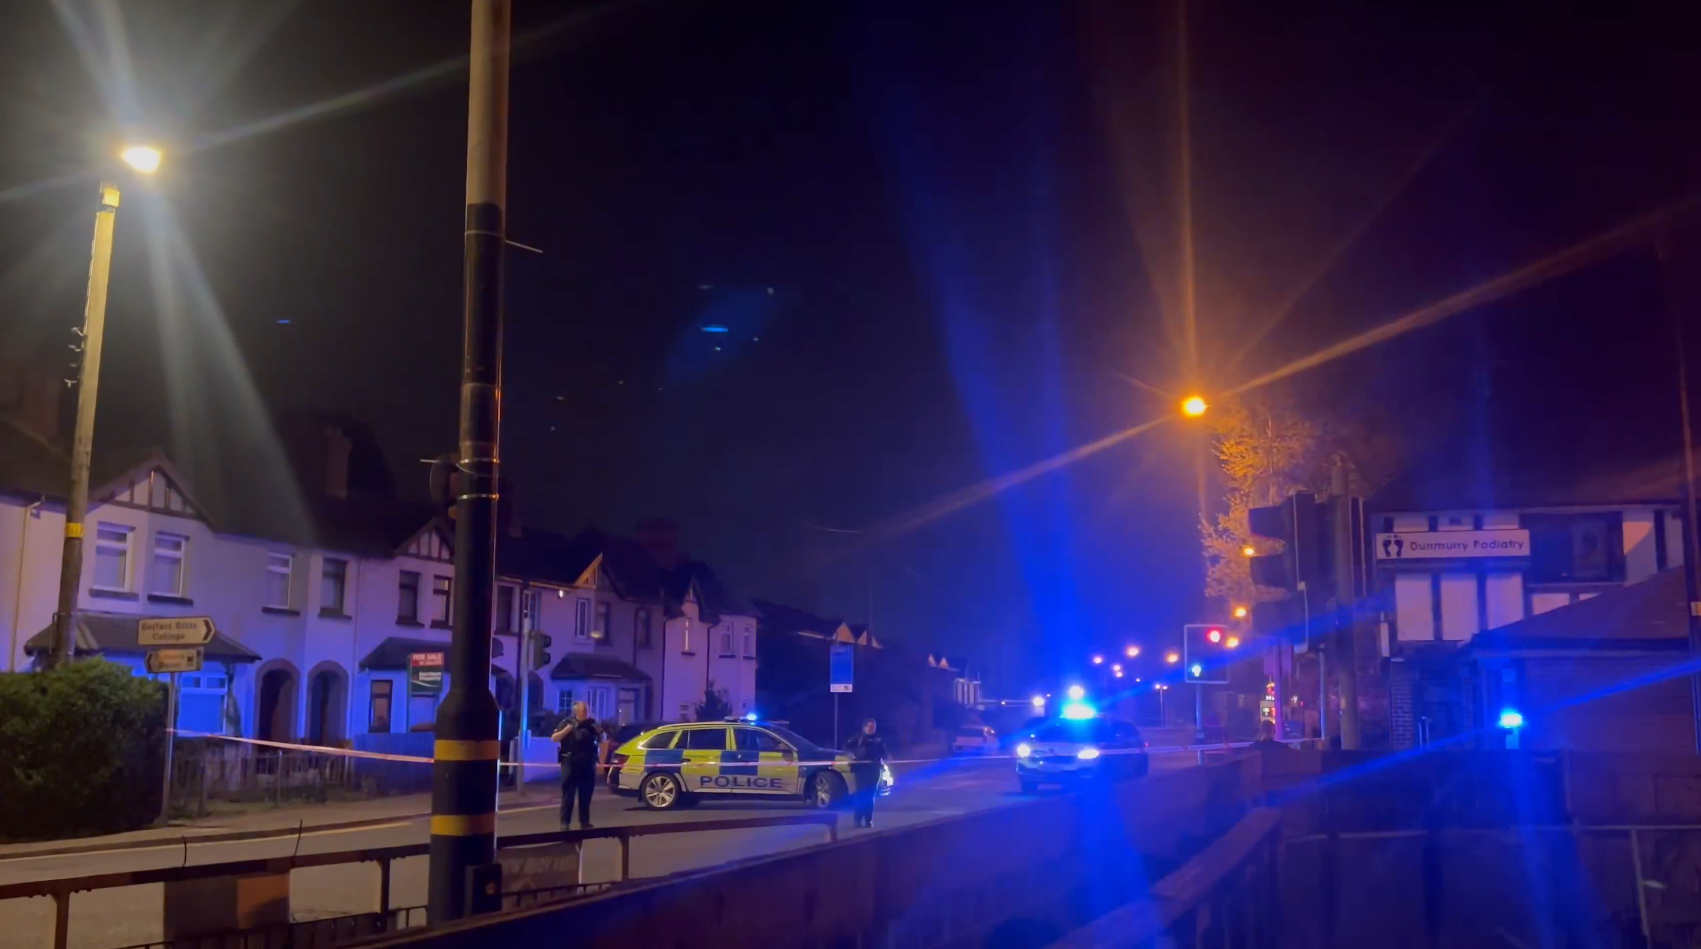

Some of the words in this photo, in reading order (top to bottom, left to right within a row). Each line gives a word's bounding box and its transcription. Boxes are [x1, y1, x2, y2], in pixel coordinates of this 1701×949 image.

[1410, 541, 1468, 552] Dunmurry
[1473, 539, 1524, 550] Podiatry
[426, 652, 441, 660] SALE
[699, 775, 783, 788] POLICE
